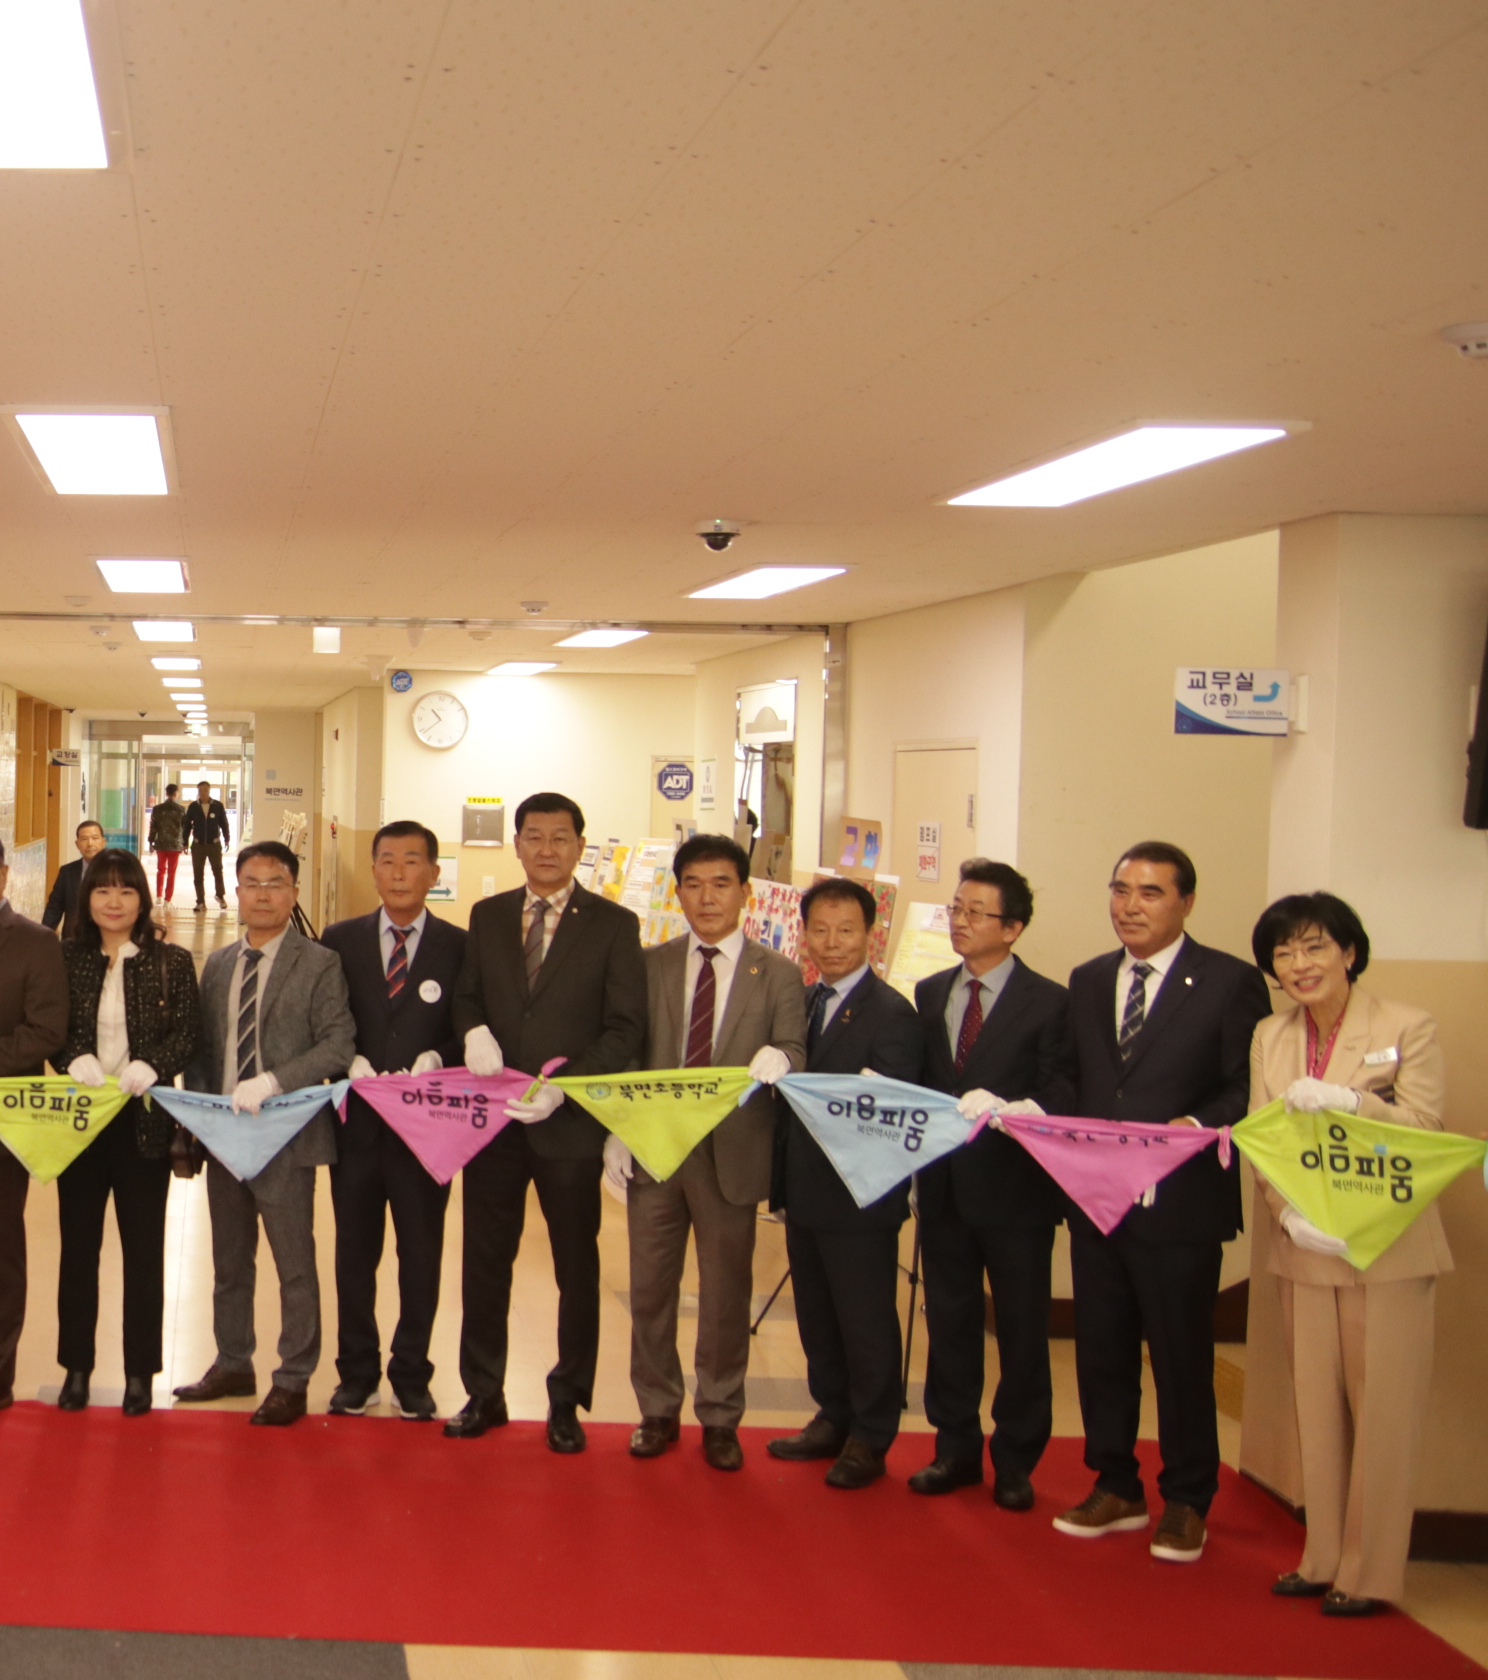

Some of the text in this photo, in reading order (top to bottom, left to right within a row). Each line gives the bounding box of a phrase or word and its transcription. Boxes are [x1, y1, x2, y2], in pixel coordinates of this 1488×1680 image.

[1188, 671, 1253, 691] 교무실
[1203, 693, 1238, 706] (2층)
[663, 775, 690, 789] ADT
[265, 788, 303, 796] 북면역사관
[620, 1081, 719, 1101] 북면초등학교
[429, 1109, 468, 1122] 북면역사관
[857, 1123, 901, 1142] 북면역사관
[1300, 1123, 1413, 1203] 이음피움
[1332, 1178, 1385, 1196] 북면역사관
